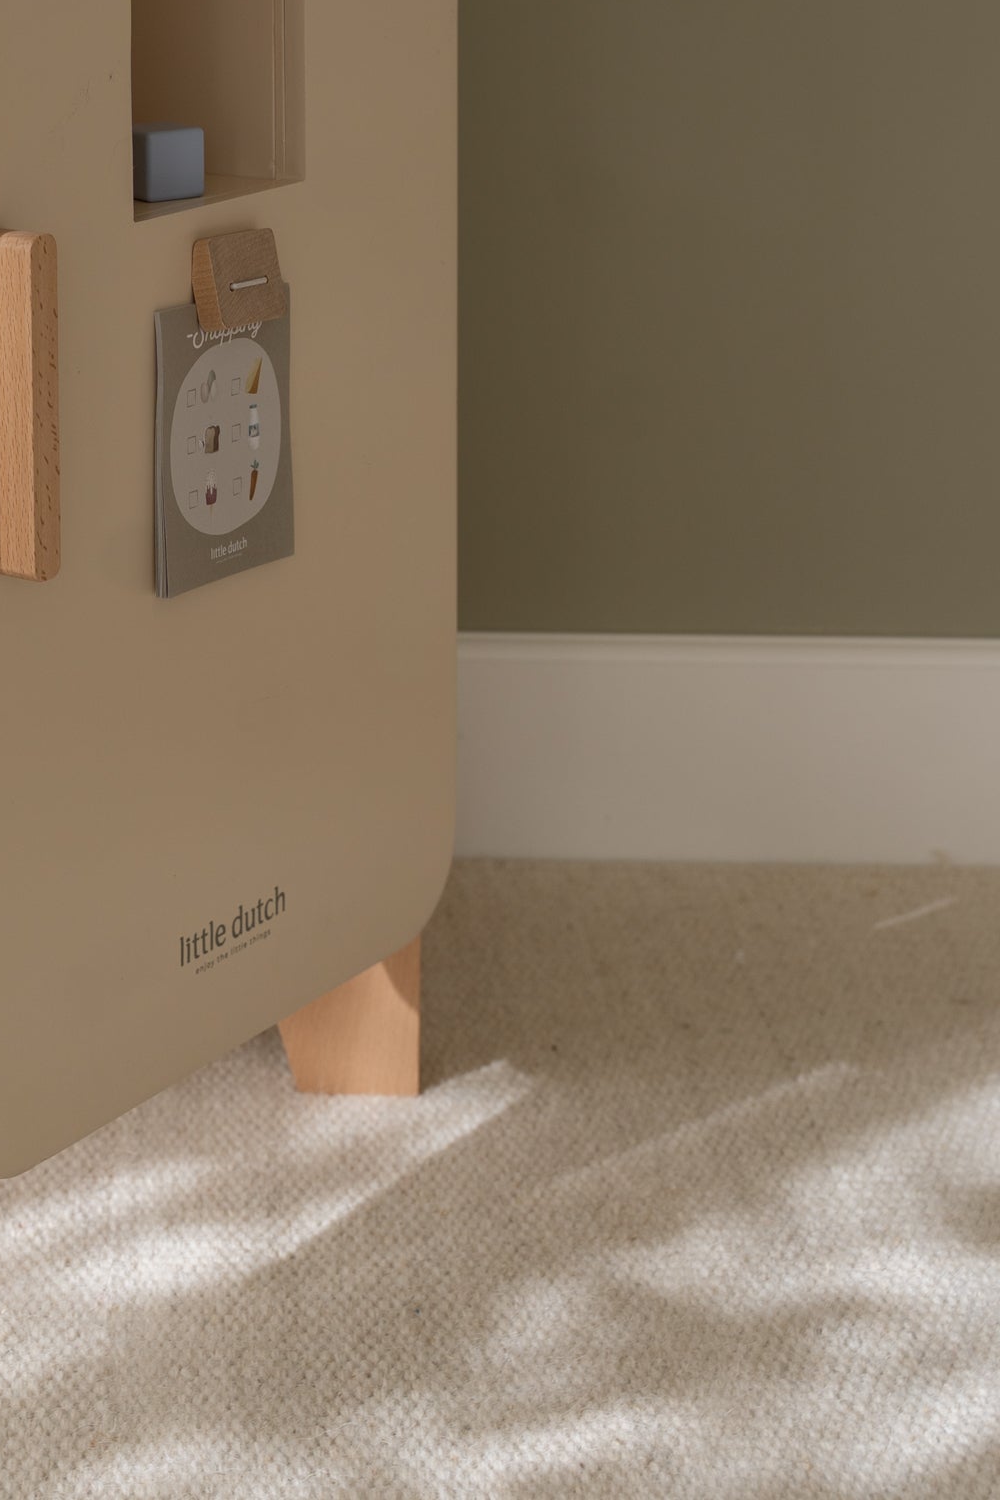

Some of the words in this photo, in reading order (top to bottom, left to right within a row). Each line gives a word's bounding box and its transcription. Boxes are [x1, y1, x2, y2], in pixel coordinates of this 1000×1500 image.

[210, 544, 227, 560] little
[227, 536, 248, 554] dutch
[179, 920, 227, 968] little
[231, 885, 286, 939] dutch
